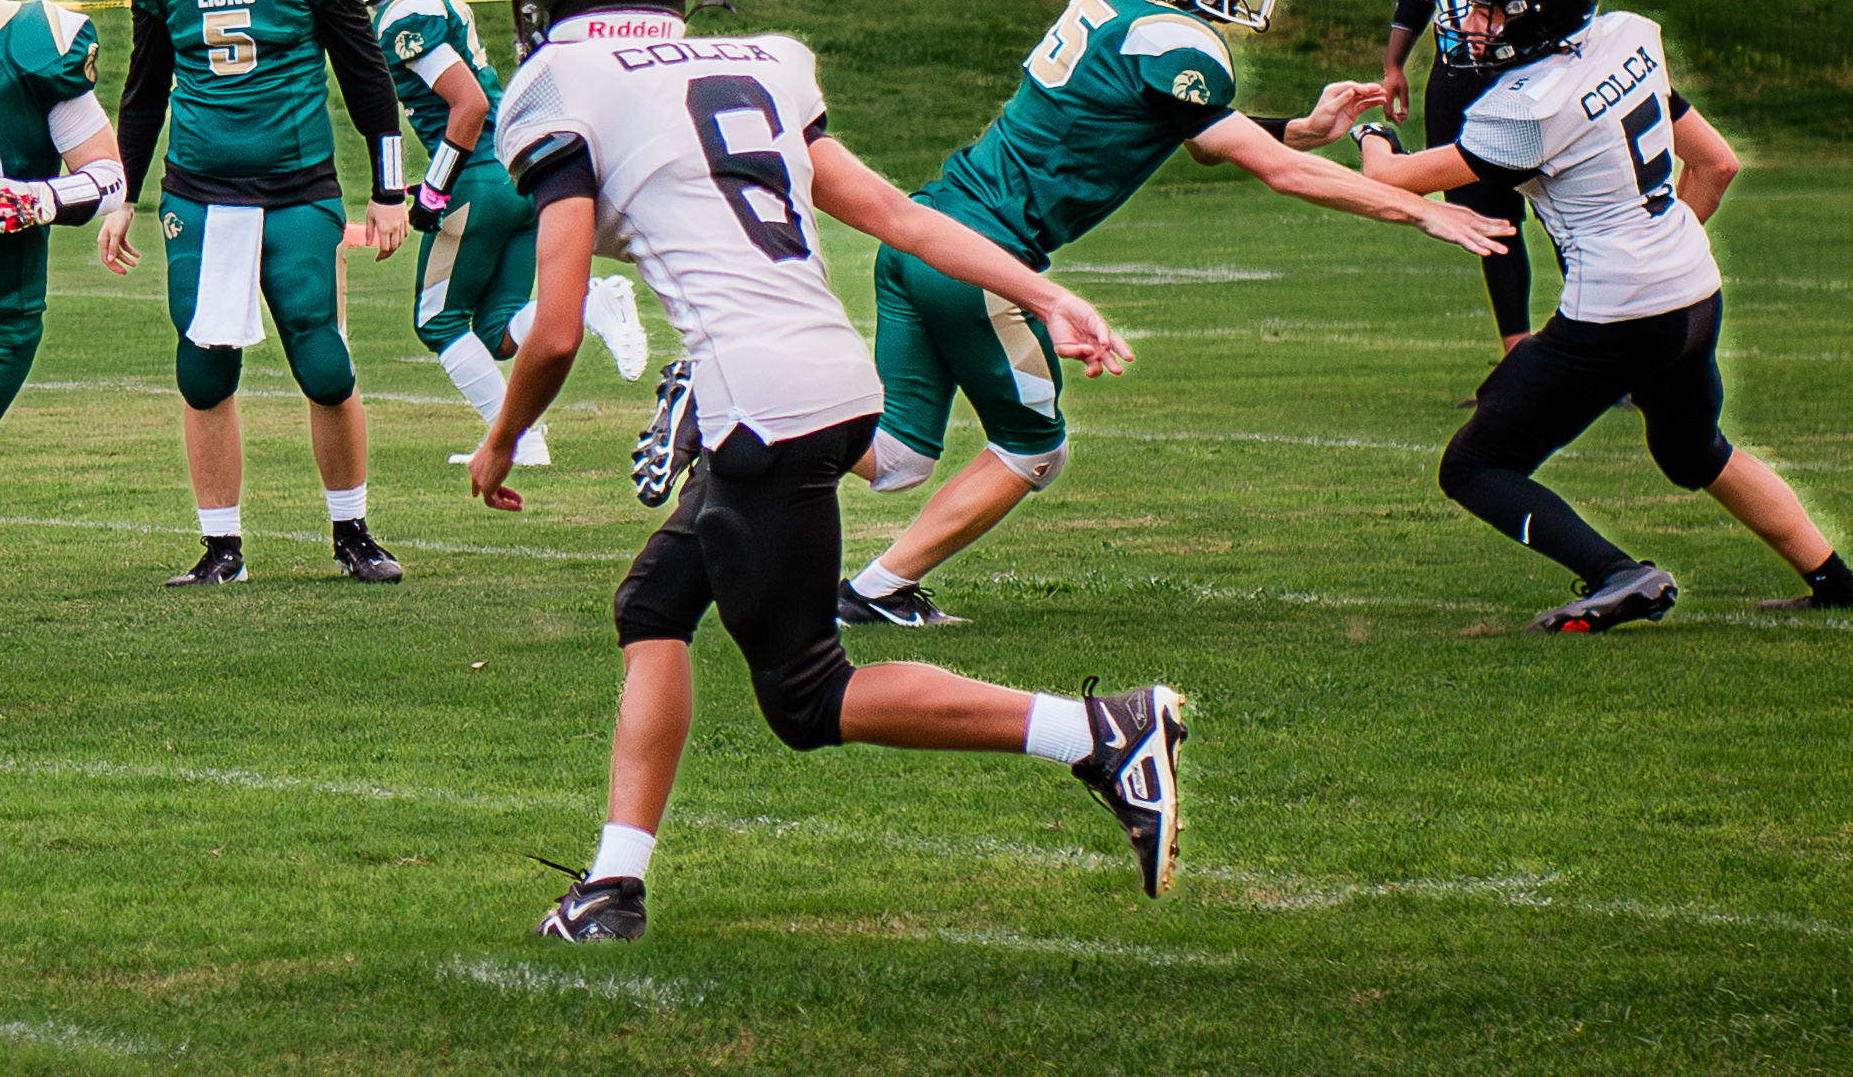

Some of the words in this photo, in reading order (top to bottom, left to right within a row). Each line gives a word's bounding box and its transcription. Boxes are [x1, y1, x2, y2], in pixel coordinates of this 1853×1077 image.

[202, 7, 258, 77] 5
[587, 21, 673, 40] Riddell
[611, 42, 780, 72] COLCA
[1508, 77, 1529, 91] 5
[1580, 45, 1658, 121] COLCA
[685, 74, 812, 263] 6
[1620, 91, 1676, 219] 5
